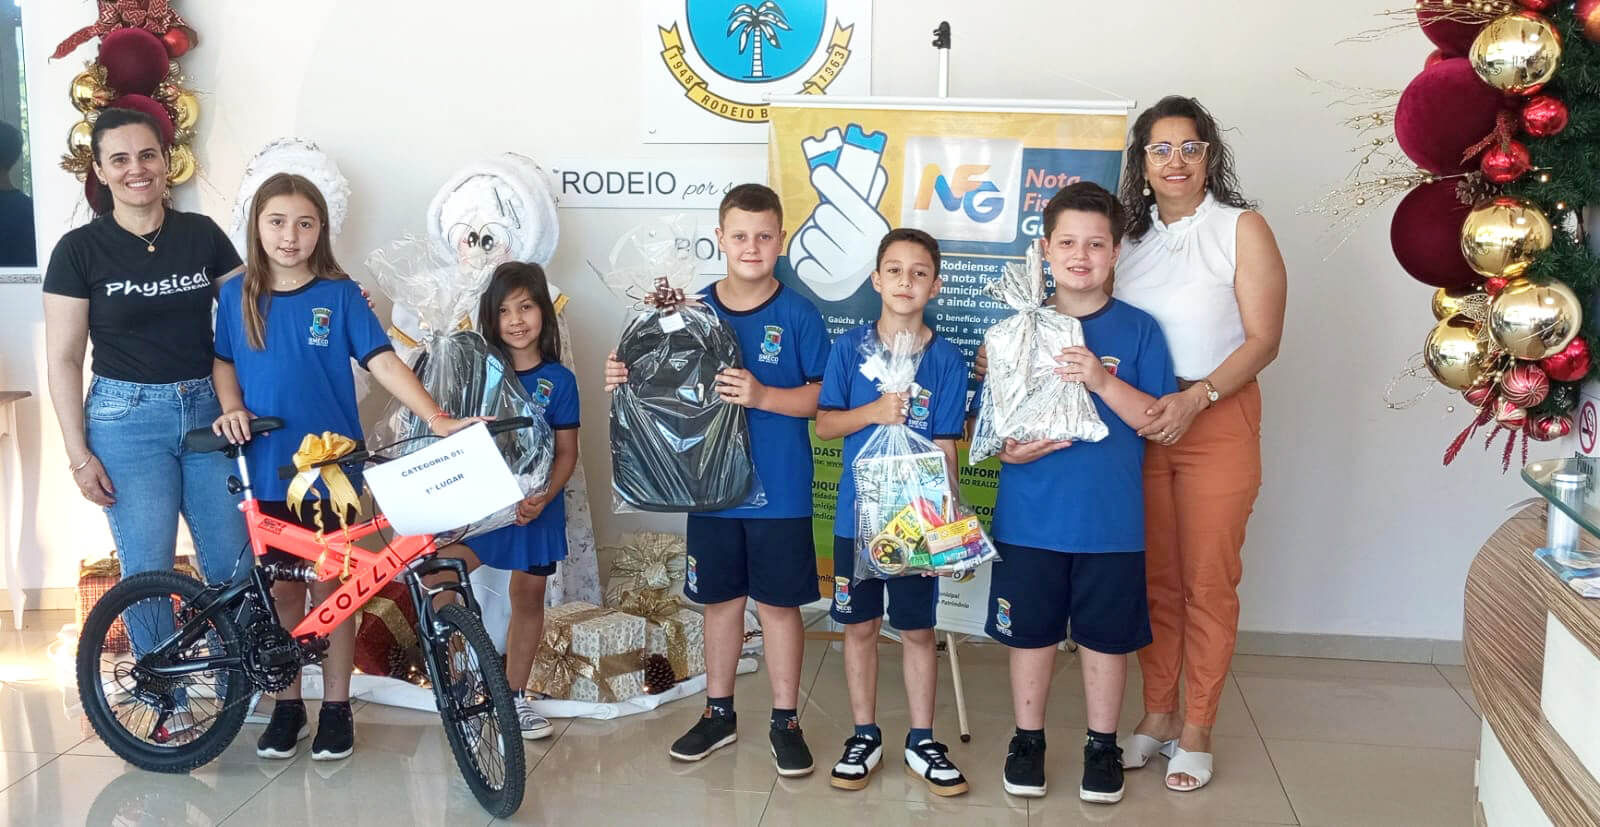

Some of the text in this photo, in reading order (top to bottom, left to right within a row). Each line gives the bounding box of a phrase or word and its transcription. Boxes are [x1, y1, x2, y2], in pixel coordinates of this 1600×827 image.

[668, 53, 693, 84] 1948
[819, 50, 845, 83] 1963
[700, 94, 755, 119] RODEIO
[562, 171, 677, 195] RODEIO
[682, 183, 719, 200] por
[913, 163, 1006, 224] NFG
[940, 259, 998, 273] Rodeiense:
[105, 266, 210, 297] Physical
[952, 274, 976, 284] nota
[937, 298, 945, 306] e
[947, 296, 977, 308] ainda
[828, 315, 855, 325] Gaúcha
[936, 313, 943, 321] O
[946, 313, 981, 324] benefício
[936, 324, 958, 333] fiscal
[973, 327, 986, 335] atr
[401, 455, 450, 477] CATEGORIA
[435, 473, 465, 491] LUGAR
[318, 555, 397, 625] COLLI
